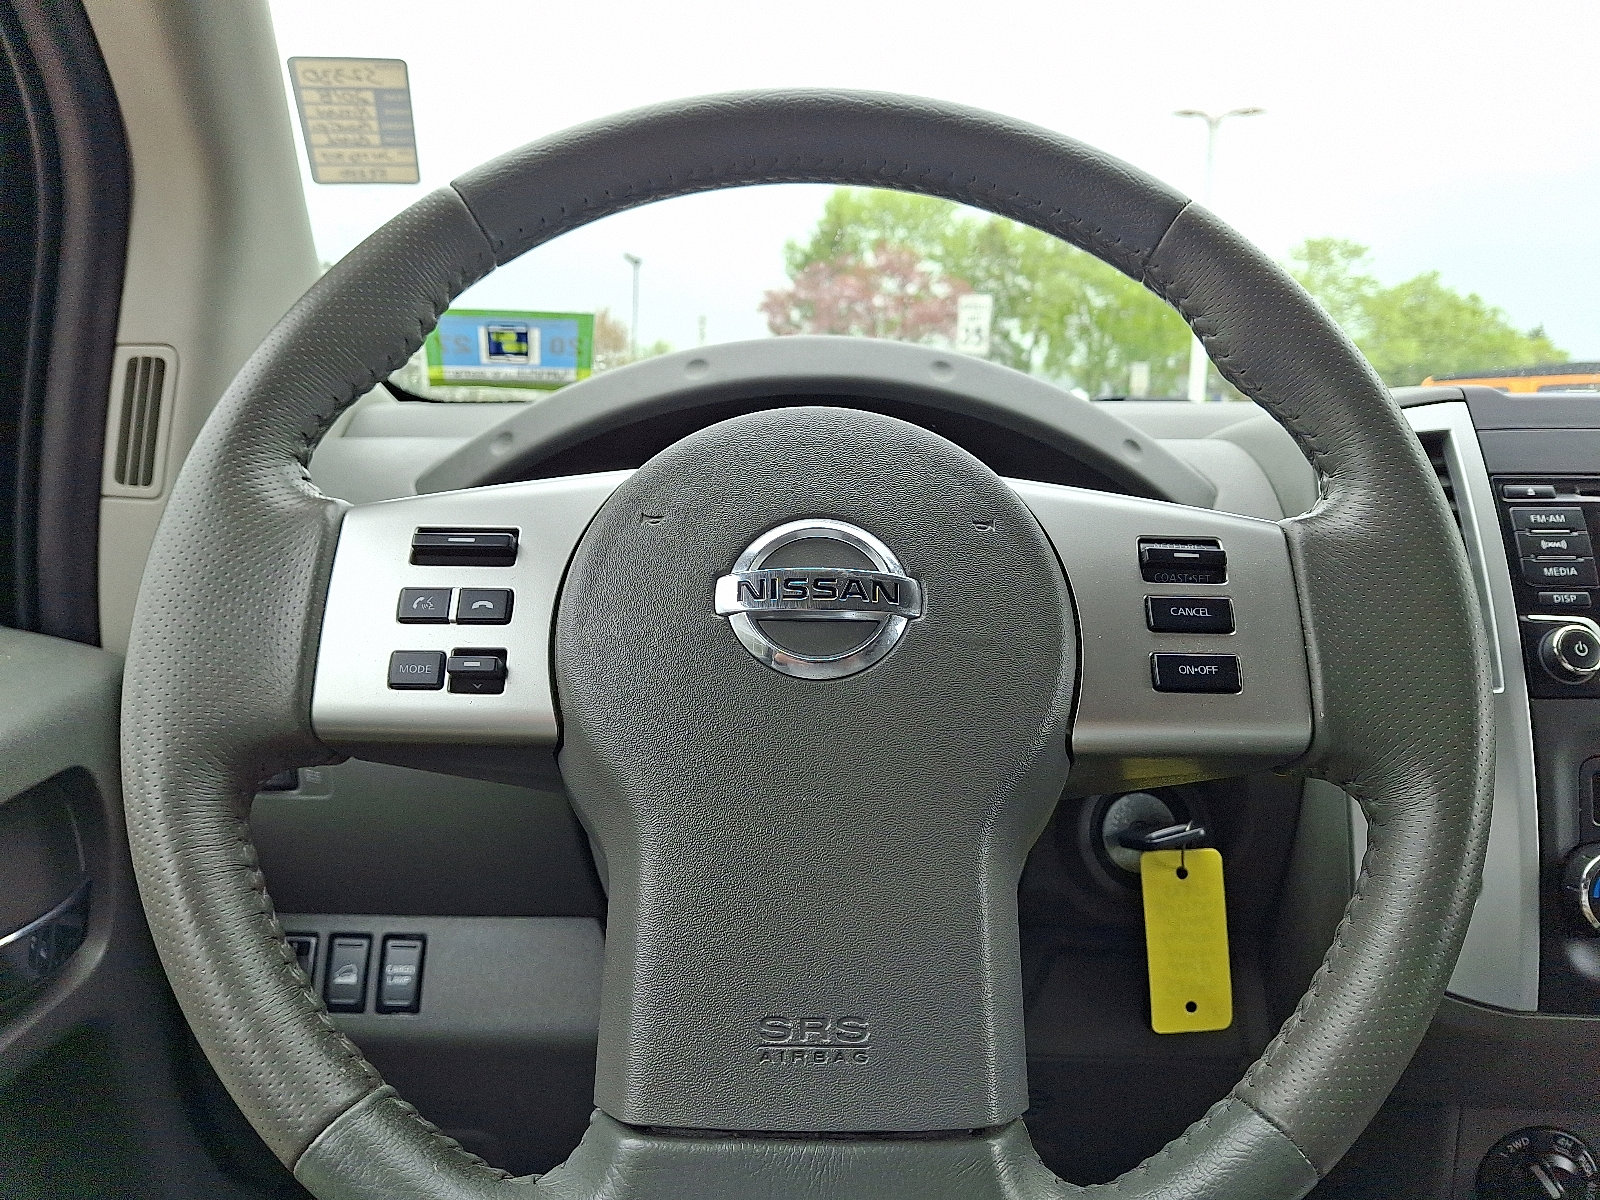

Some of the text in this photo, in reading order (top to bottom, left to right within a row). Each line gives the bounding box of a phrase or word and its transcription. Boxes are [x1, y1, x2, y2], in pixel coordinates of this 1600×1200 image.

[1543, 567, 1578, 576] MEDIA
[736, 576, 900, 605] NISSAN
[1552, 594, 1577, 604] DISP
[1170, 606, 1212, 617] CANCEL
[399, 663, 433, 675] MODE
[757, 1016, 871, 1043] SRS
[758, 1050, 871, 1065] AIRBAG
[1506, 1136, 1530, 1153] 2WD
